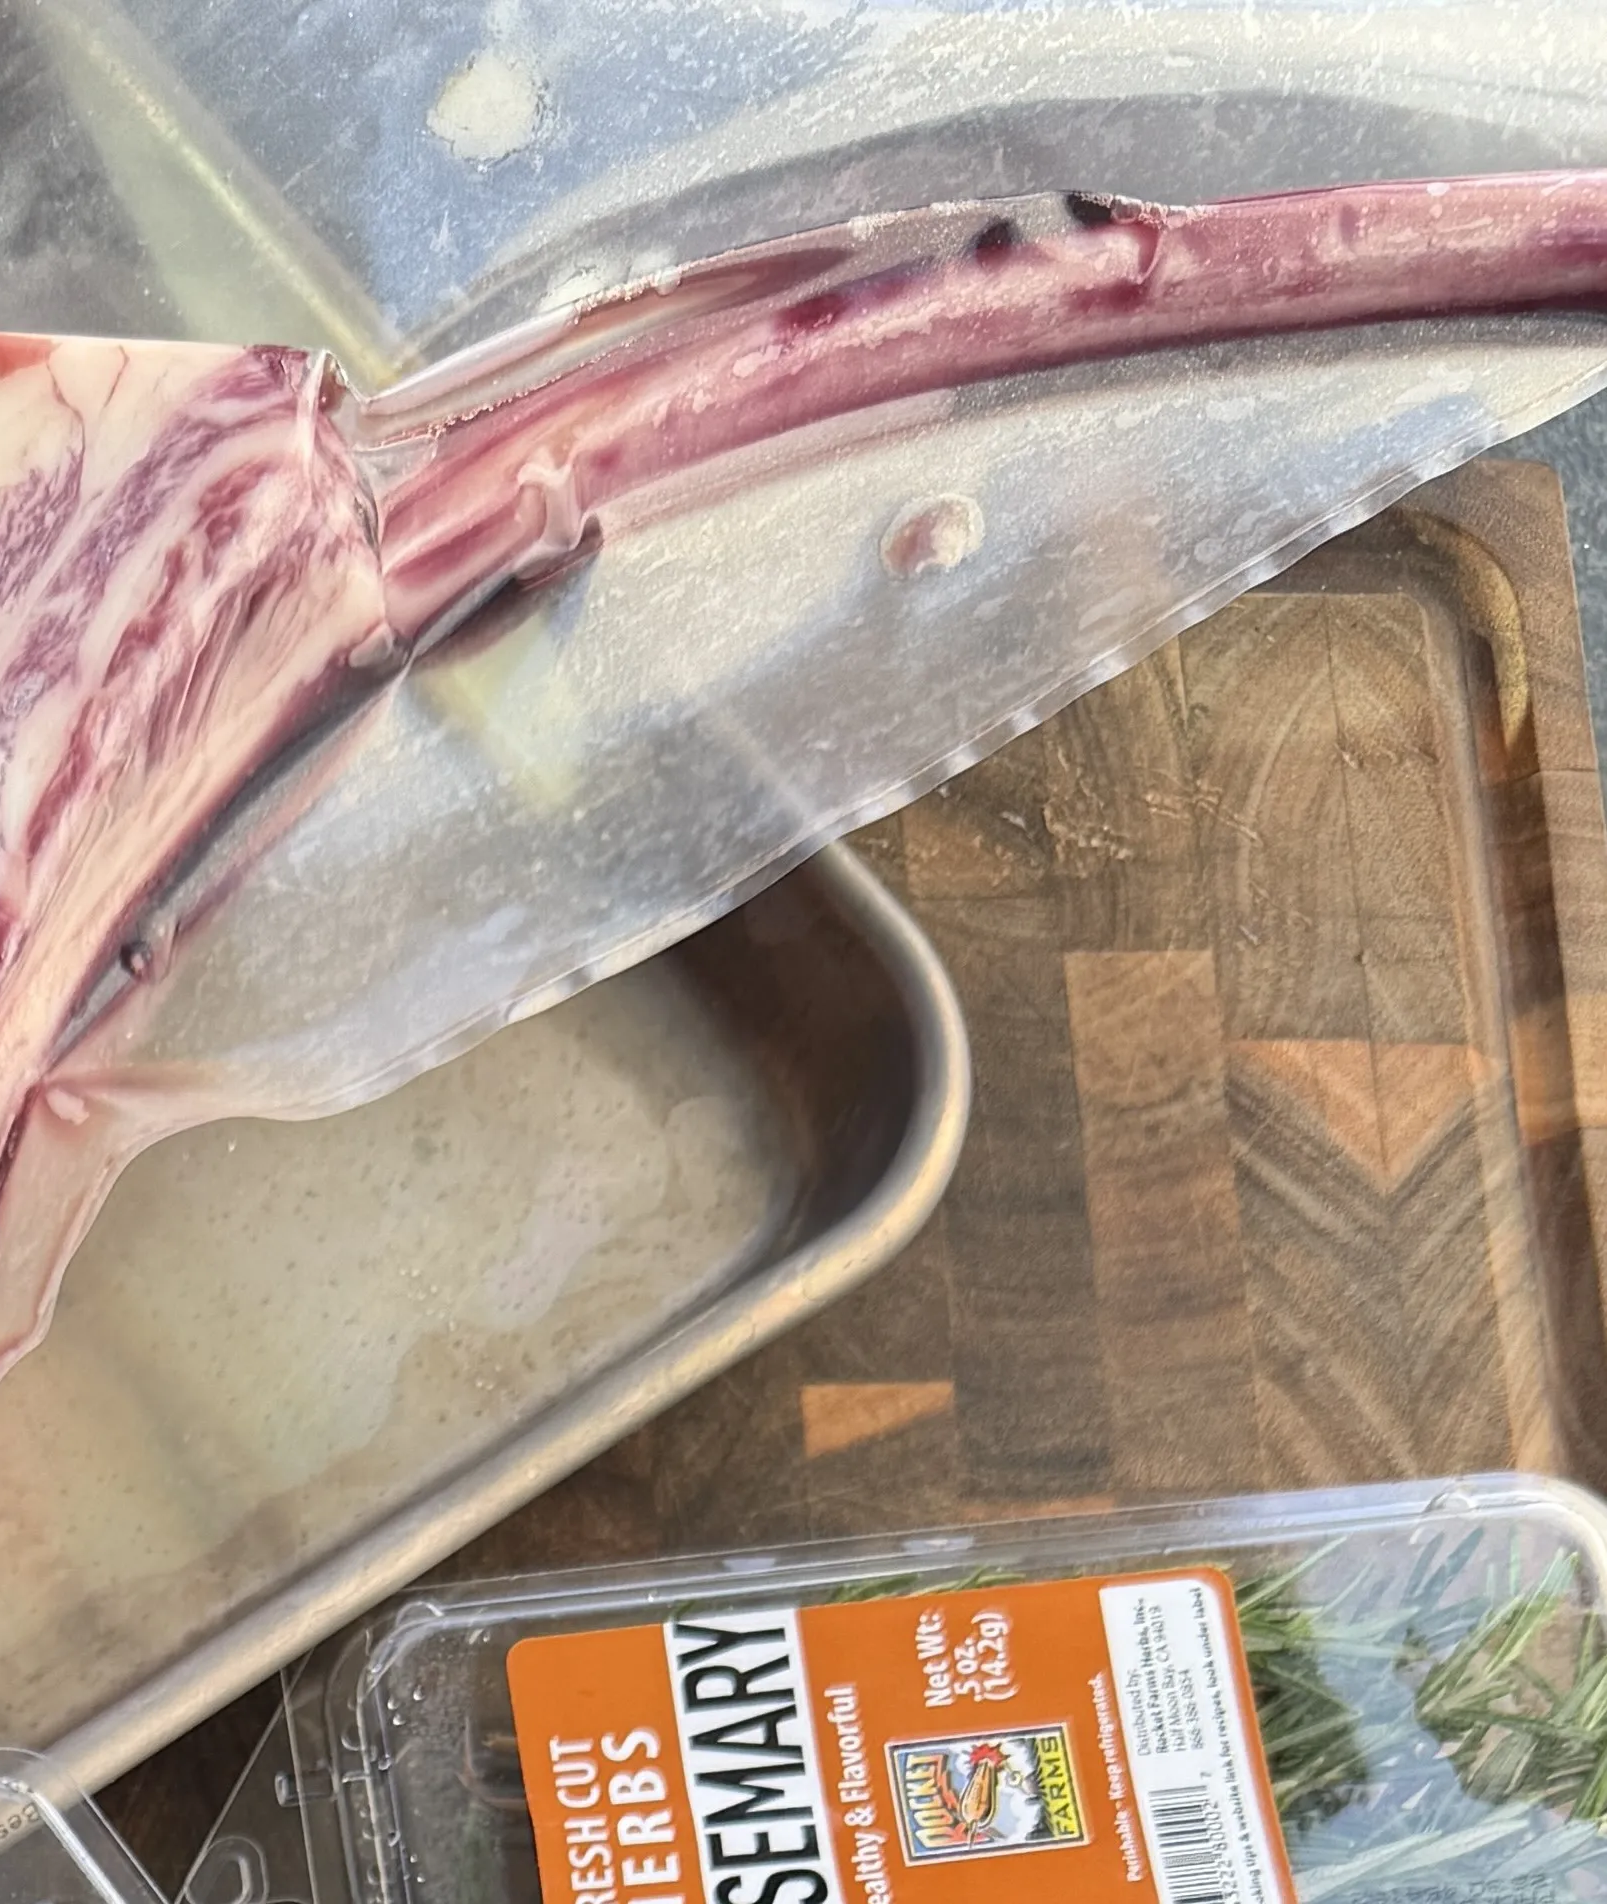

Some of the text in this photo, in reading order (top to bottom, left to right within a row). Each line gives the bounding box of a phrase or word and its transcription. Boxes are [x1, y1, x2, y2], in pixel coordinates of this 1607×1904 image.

[1188, 1586, 1206, 1619] label
[915, 1612, 953, 1706] Net Wt:
[954, 1636, 978, 1674] oz.
[971, 1611, 1017, 1699] (14.2g)
[1154, 1643, 1170, 1663] CA
[1141, 1669, 1161, 1709] Farms
[1163, 1690, 1182, 1727] Moon
[824, 1684, 869, 1802] Flavorful
[1088, 1673, 1117, 1764] refrigerated.
[1124, 1688, 1152, 1757] Distributed
[1148, 1709, 1169, 1754] Rocket
[549, 1735, 600, 1808] CUT
[901, 1747, 994, 1852] ROCKET
[1037, 1732, 1077, 1838] FARMS
[1105, 1764, 1124, 1800] Keep
[844, 1805, 875, 1826] &
[1225, 1783, 1247, 1831] website
[1115, 1809, 1142, 1883] Perishable
